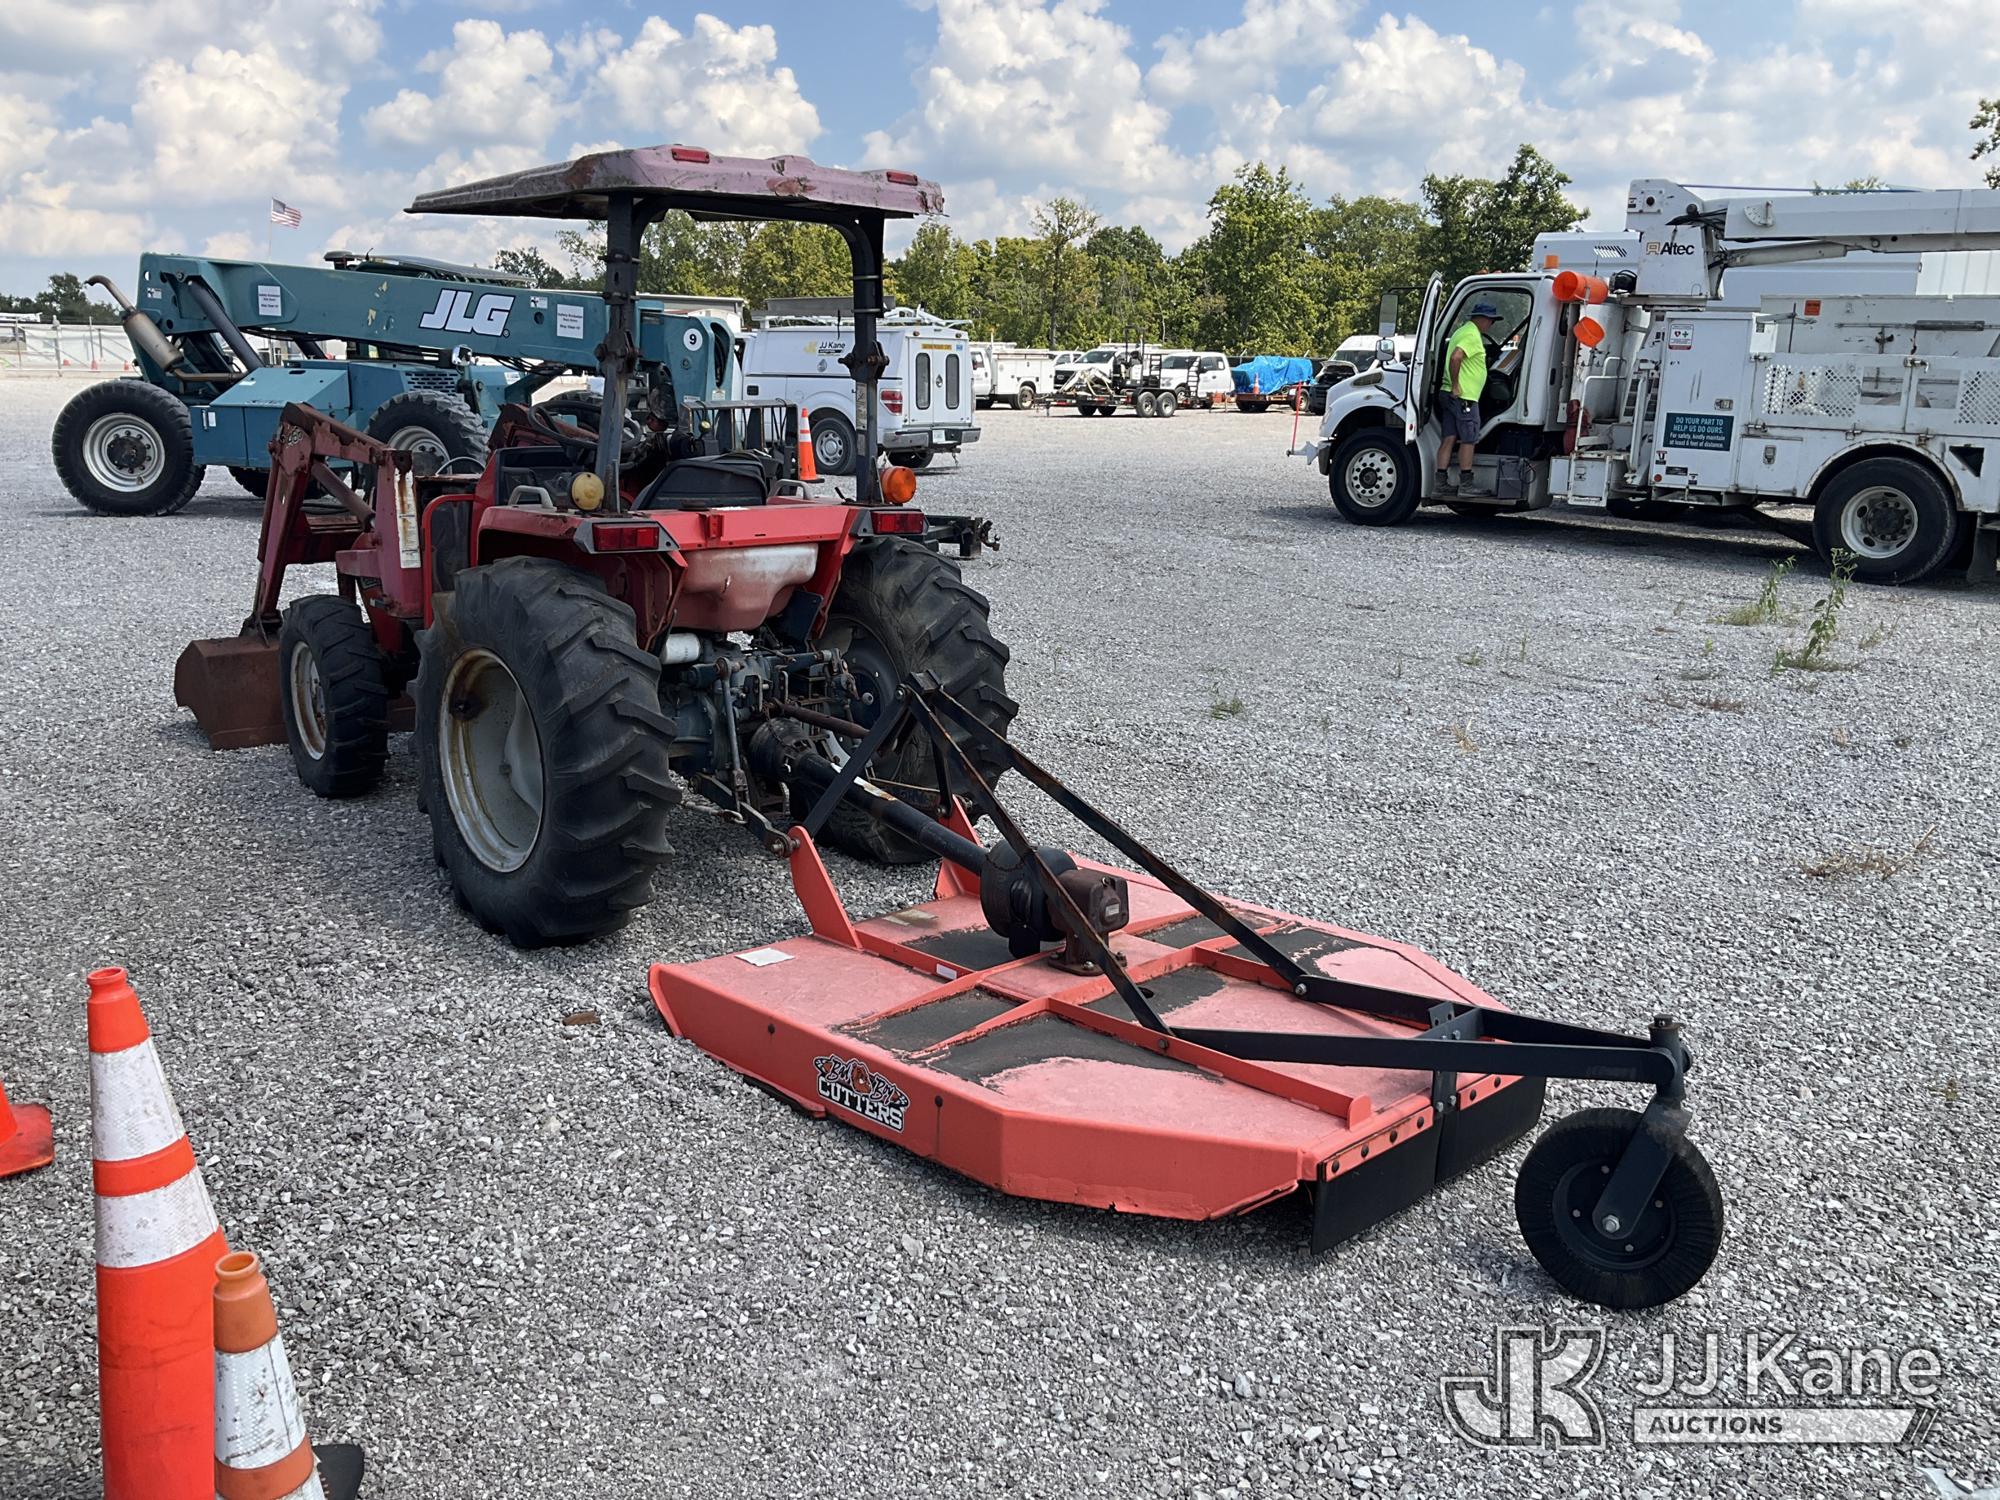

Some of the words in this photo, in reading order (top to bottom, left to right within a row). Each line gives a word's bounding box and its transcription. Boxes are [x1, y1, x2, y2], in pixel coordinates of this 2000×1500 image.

[1660, 242, 1695, 255] Altec
[419, 288, 516, 337] JLG
[689, 334, 697, 345] 9
[819, 341, 828, 349] JJ
[828, 341, 846, 349] Kane
[1685, 417, 1700, 425] YOUR
[1701, 418, 1715, 426] PART
[1673, 424, 1688, 432] HELP
[1697, 425, 1706, 433] DO
[818, 1076, 903, 1130] CUTTERS
